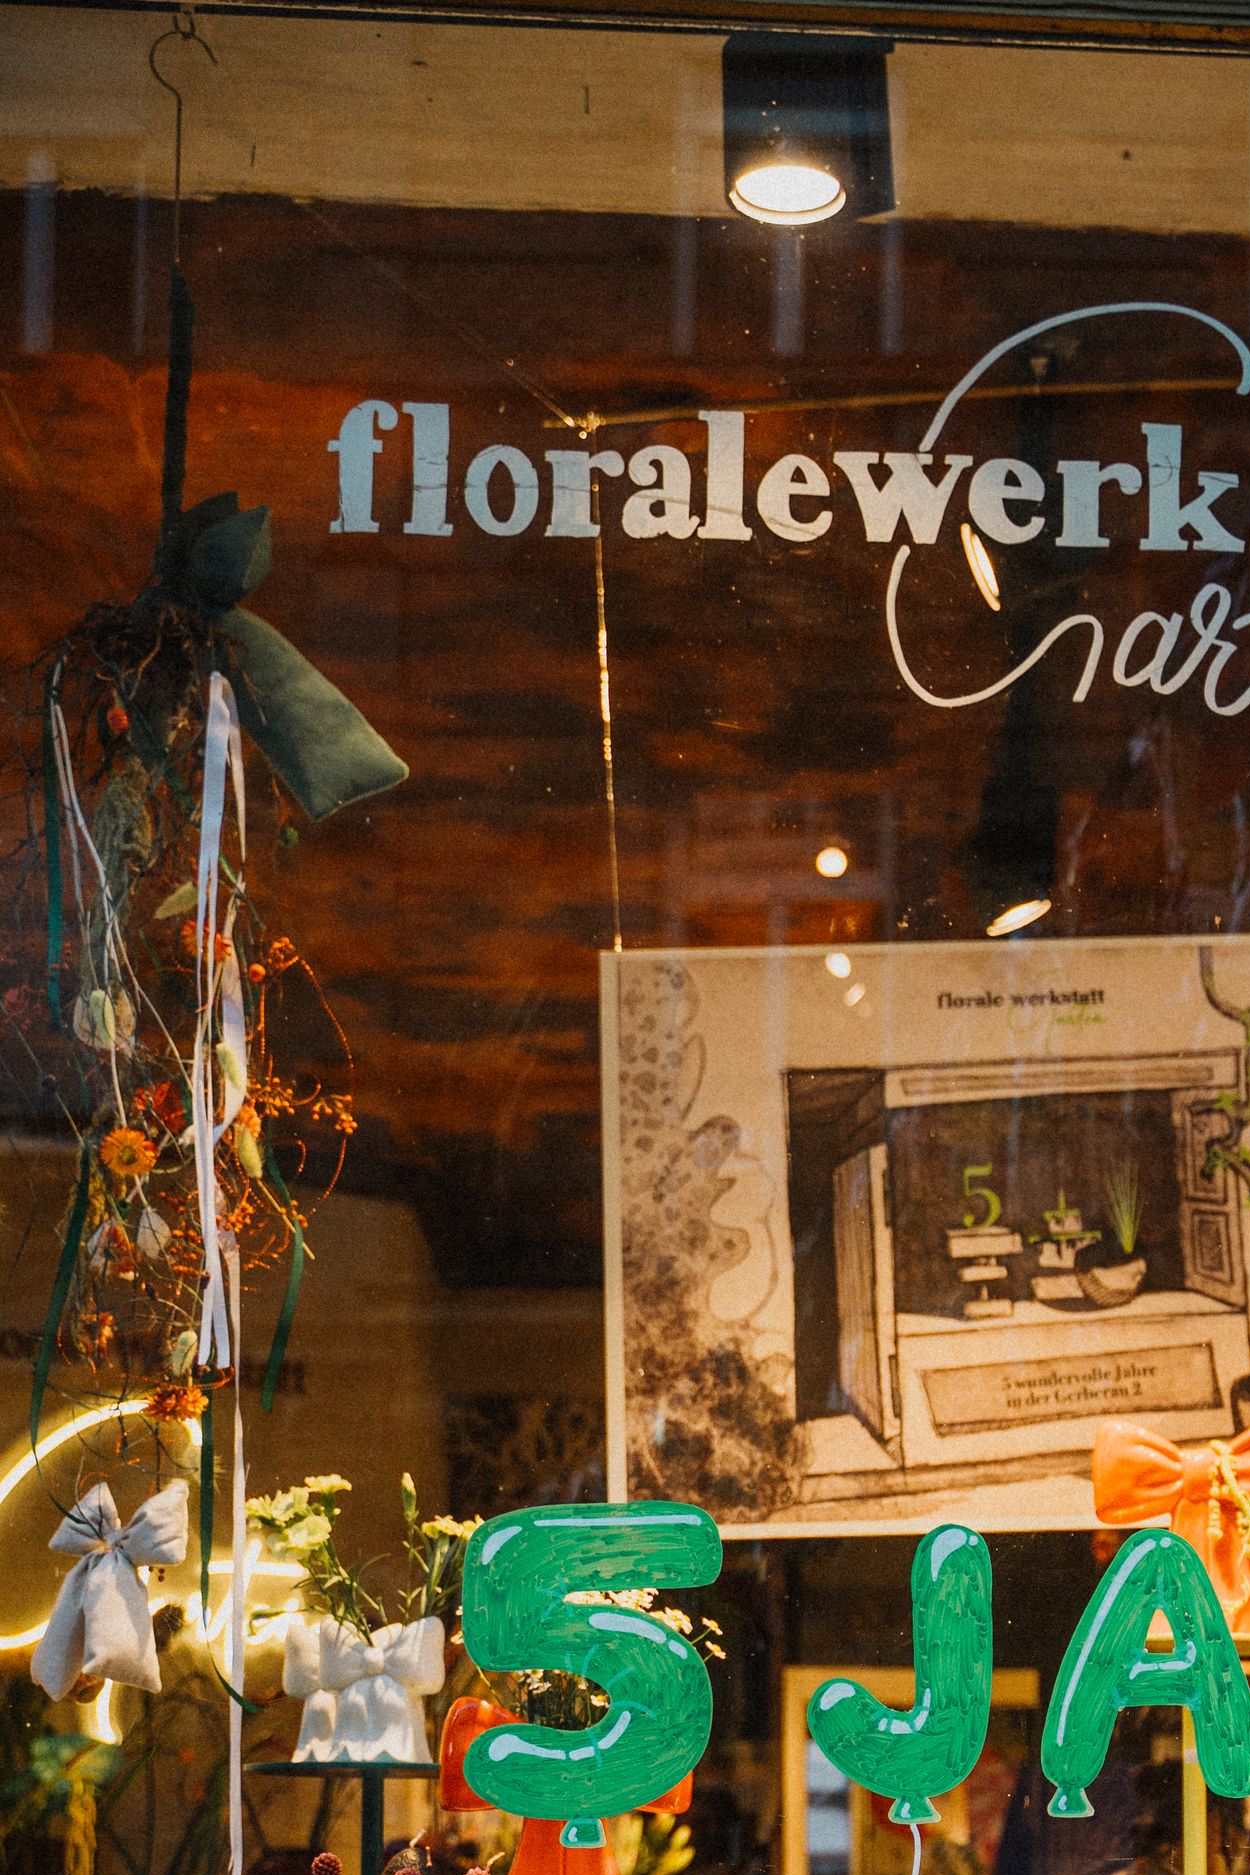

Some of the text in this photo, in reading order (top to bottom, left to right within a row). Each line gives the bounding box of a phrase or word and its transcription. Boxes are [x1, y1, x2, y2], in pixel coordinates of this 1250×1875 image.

[962, 1163, 1001, 1229] 5
[1015, 1368, 1112, 1389] wundervolle
[1115, 1362, 1158, 1382] Jahre
[1132, 1381, 1143, 1396] 2
[461, 1500, 724, 1850] 5
